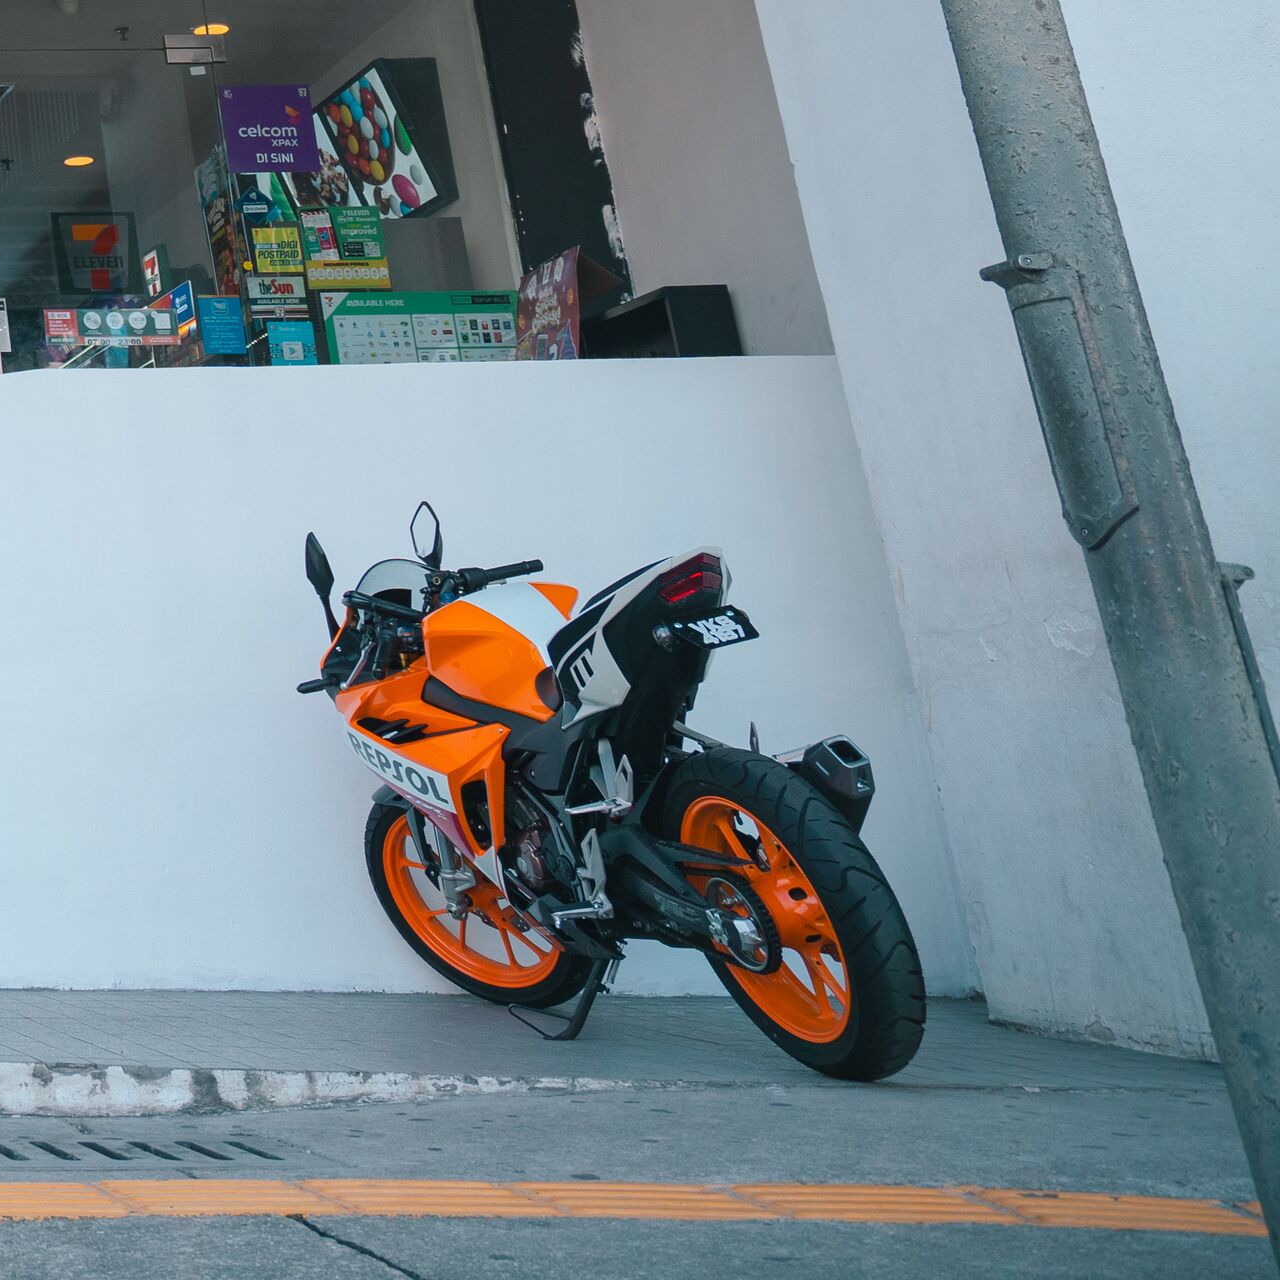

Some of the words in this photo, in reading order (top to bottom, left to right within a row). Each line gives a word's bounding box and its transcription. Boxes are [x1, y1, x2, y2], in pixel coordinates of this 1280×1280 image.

[238, 124, 297, 137] celcom
[272, 139, 298, 147] XPAX
[256, 153, 268, 163] DI
[271, 153, 294, 163] SINI
[340, 226, 377, 236] improved
[281, 240, 298, 249] DIGI
[72, 224, 119, 291] 7
[258, 250, 299, 259] POSTPAID
[259, 279, 295, 295] theSun
[347, 731, 449, 804] REPSOL
